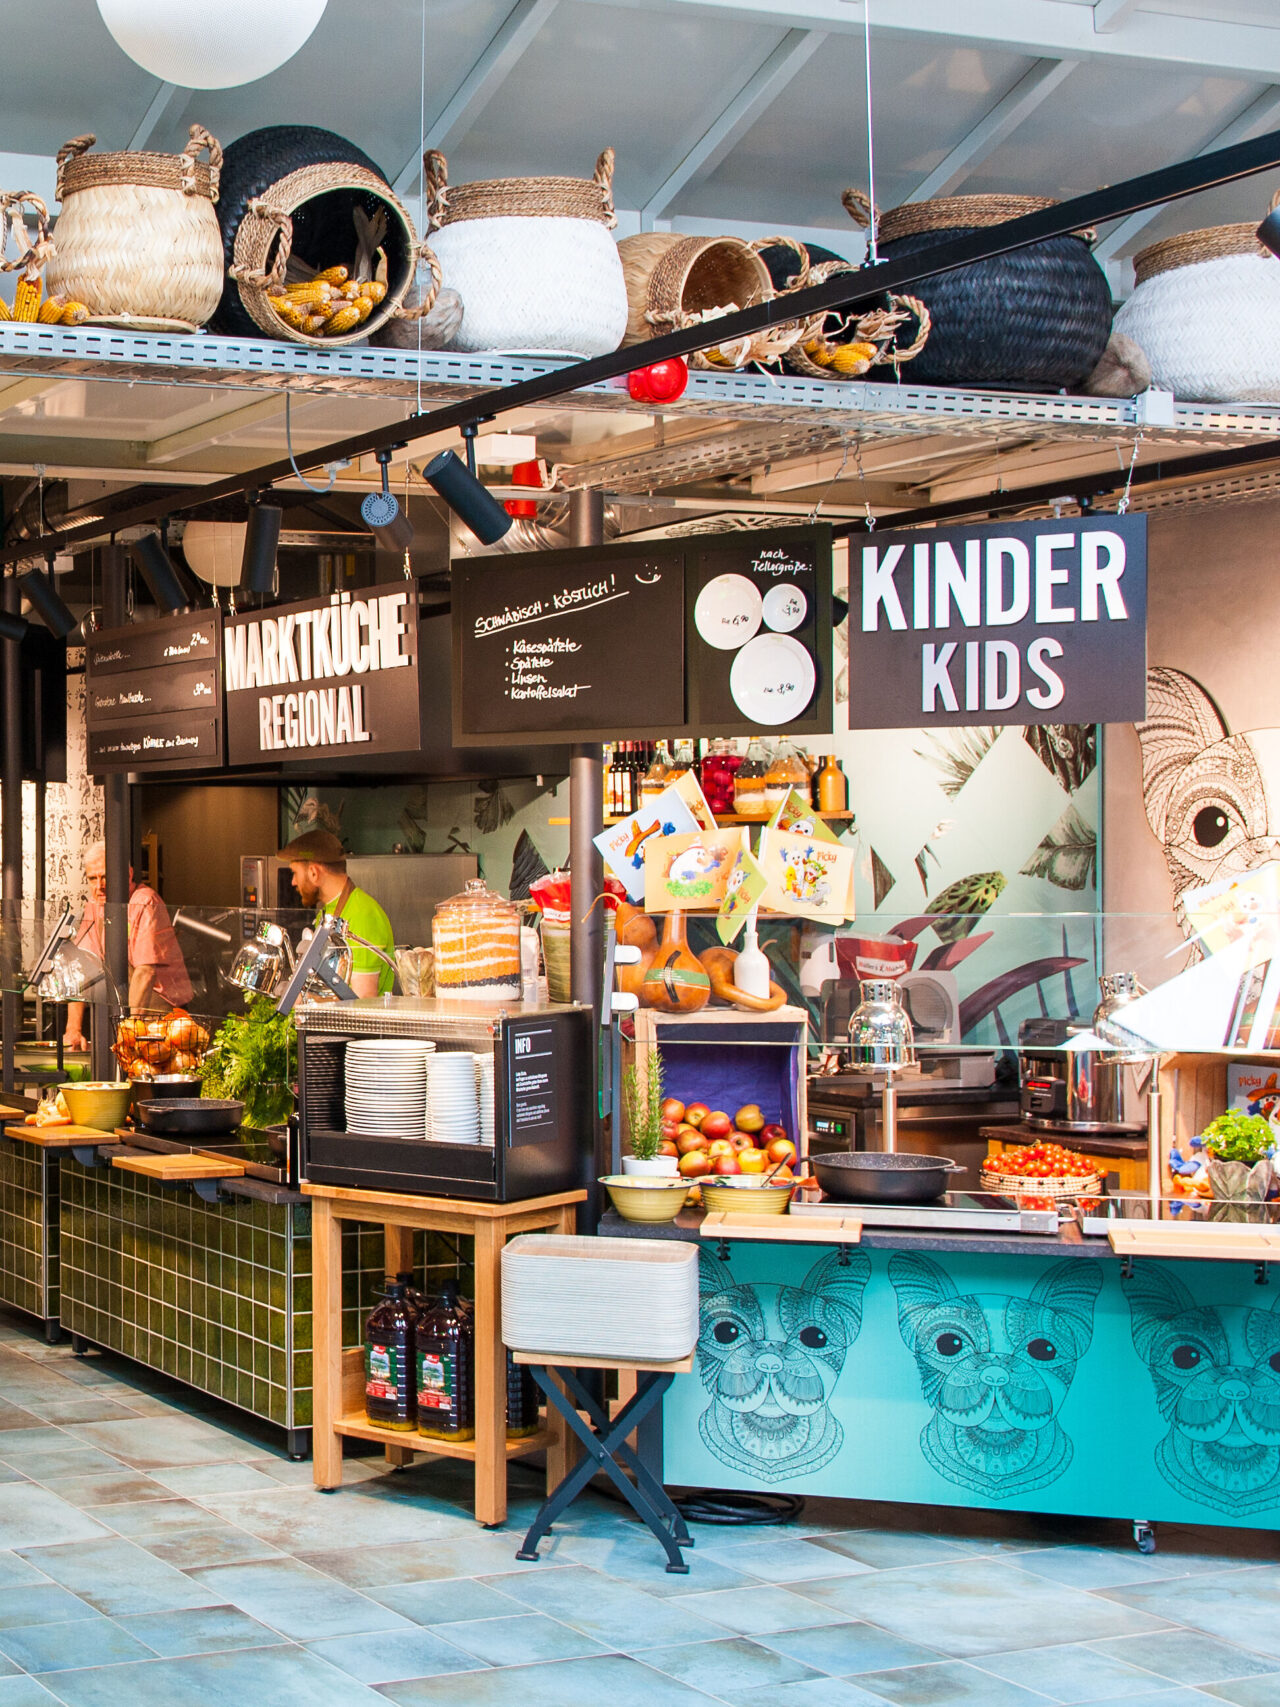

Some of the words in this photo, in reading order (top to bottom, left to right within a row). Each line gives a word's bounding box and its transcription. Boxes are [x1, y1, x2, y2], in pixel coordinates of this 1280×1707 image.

[862, 530, 1128, 632] KINDER
[224, 591, 410, 692] MARKTKÜCHE
[922, 637, 1065, 713] KIDS
[259, 684, 370, 750] REGIONAL
[817, 850, 838, 863] Picky
[515, 1037, 532, 1054] INFO
[1238, 1076, 1261, 1088] Picky
